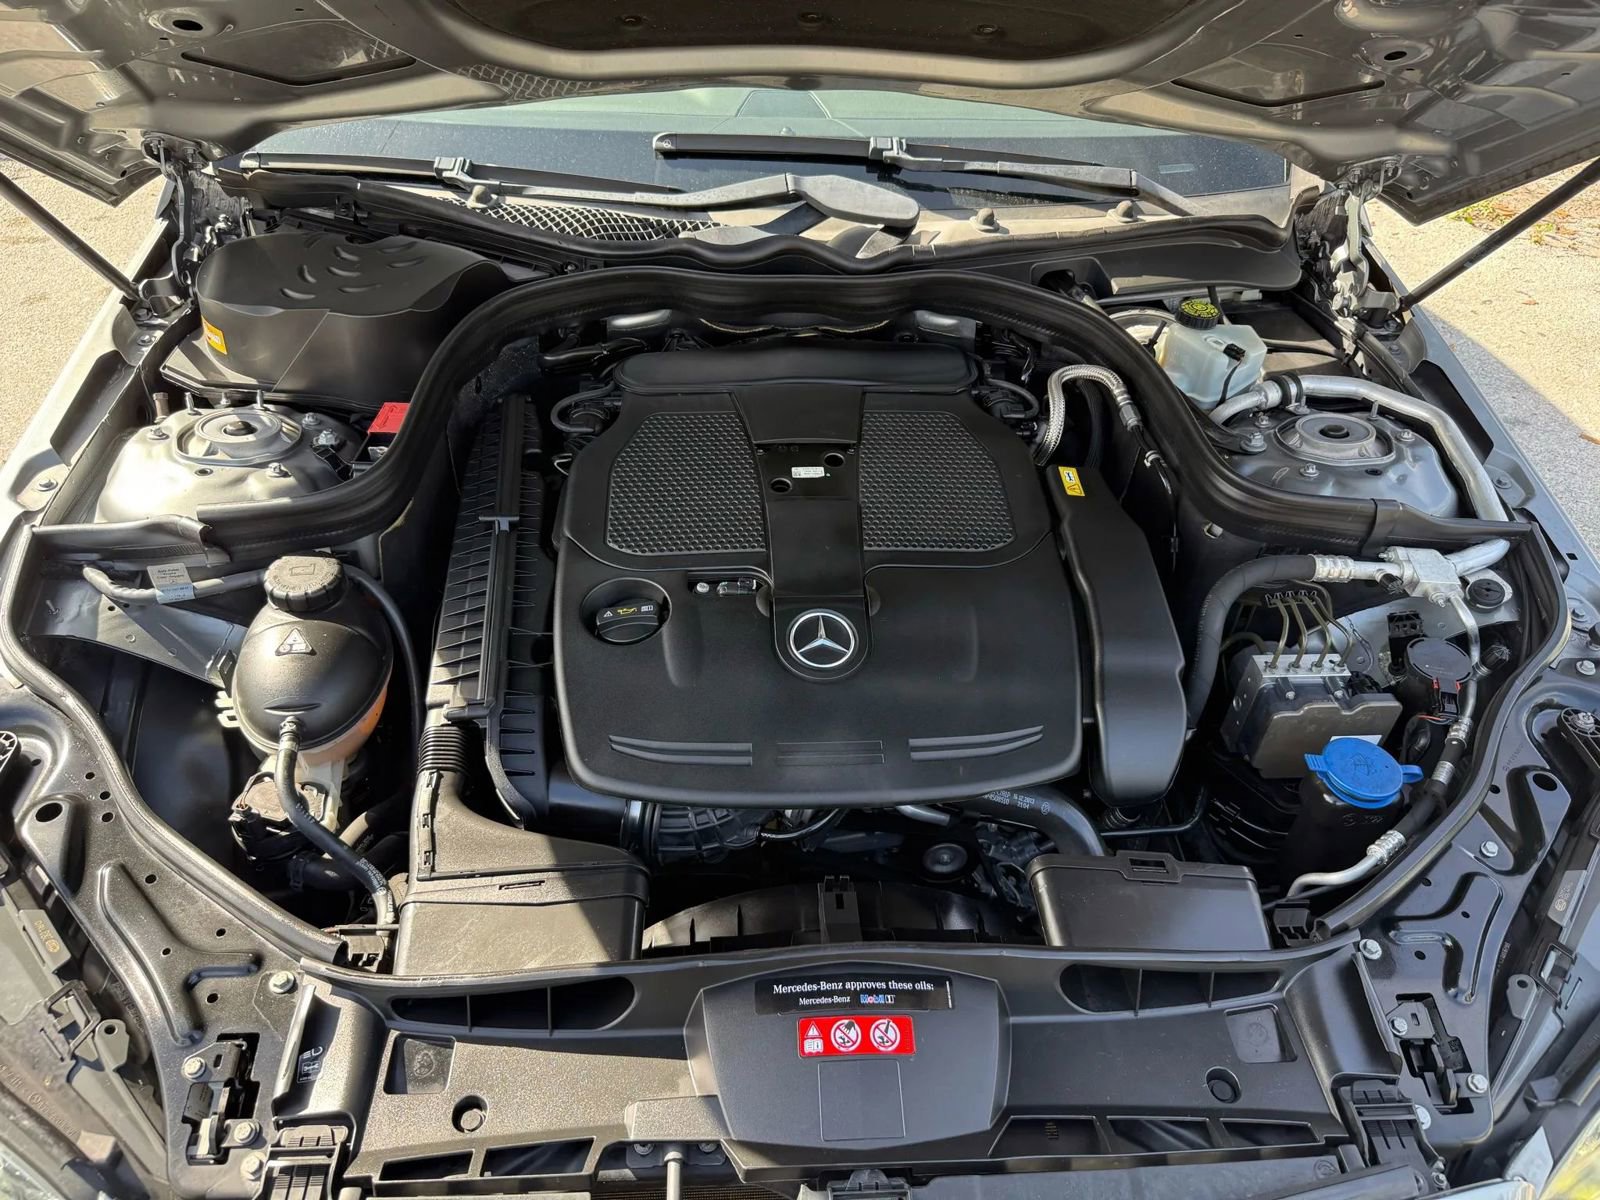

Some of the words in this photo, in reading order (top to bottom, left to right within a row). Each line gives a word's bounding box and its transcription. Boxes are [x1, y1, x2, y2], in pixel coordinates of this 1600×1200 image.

[773, 981, 843, 994] Mercedes-Benz
[845, 980, 886, 992] approves
[888, 980, 913, 990] these
[914, 980, 934, 991] oils:
[799, 995, 850, 1005] Mercedes-Benz
[860, 994, 884, 1004] Mobil
